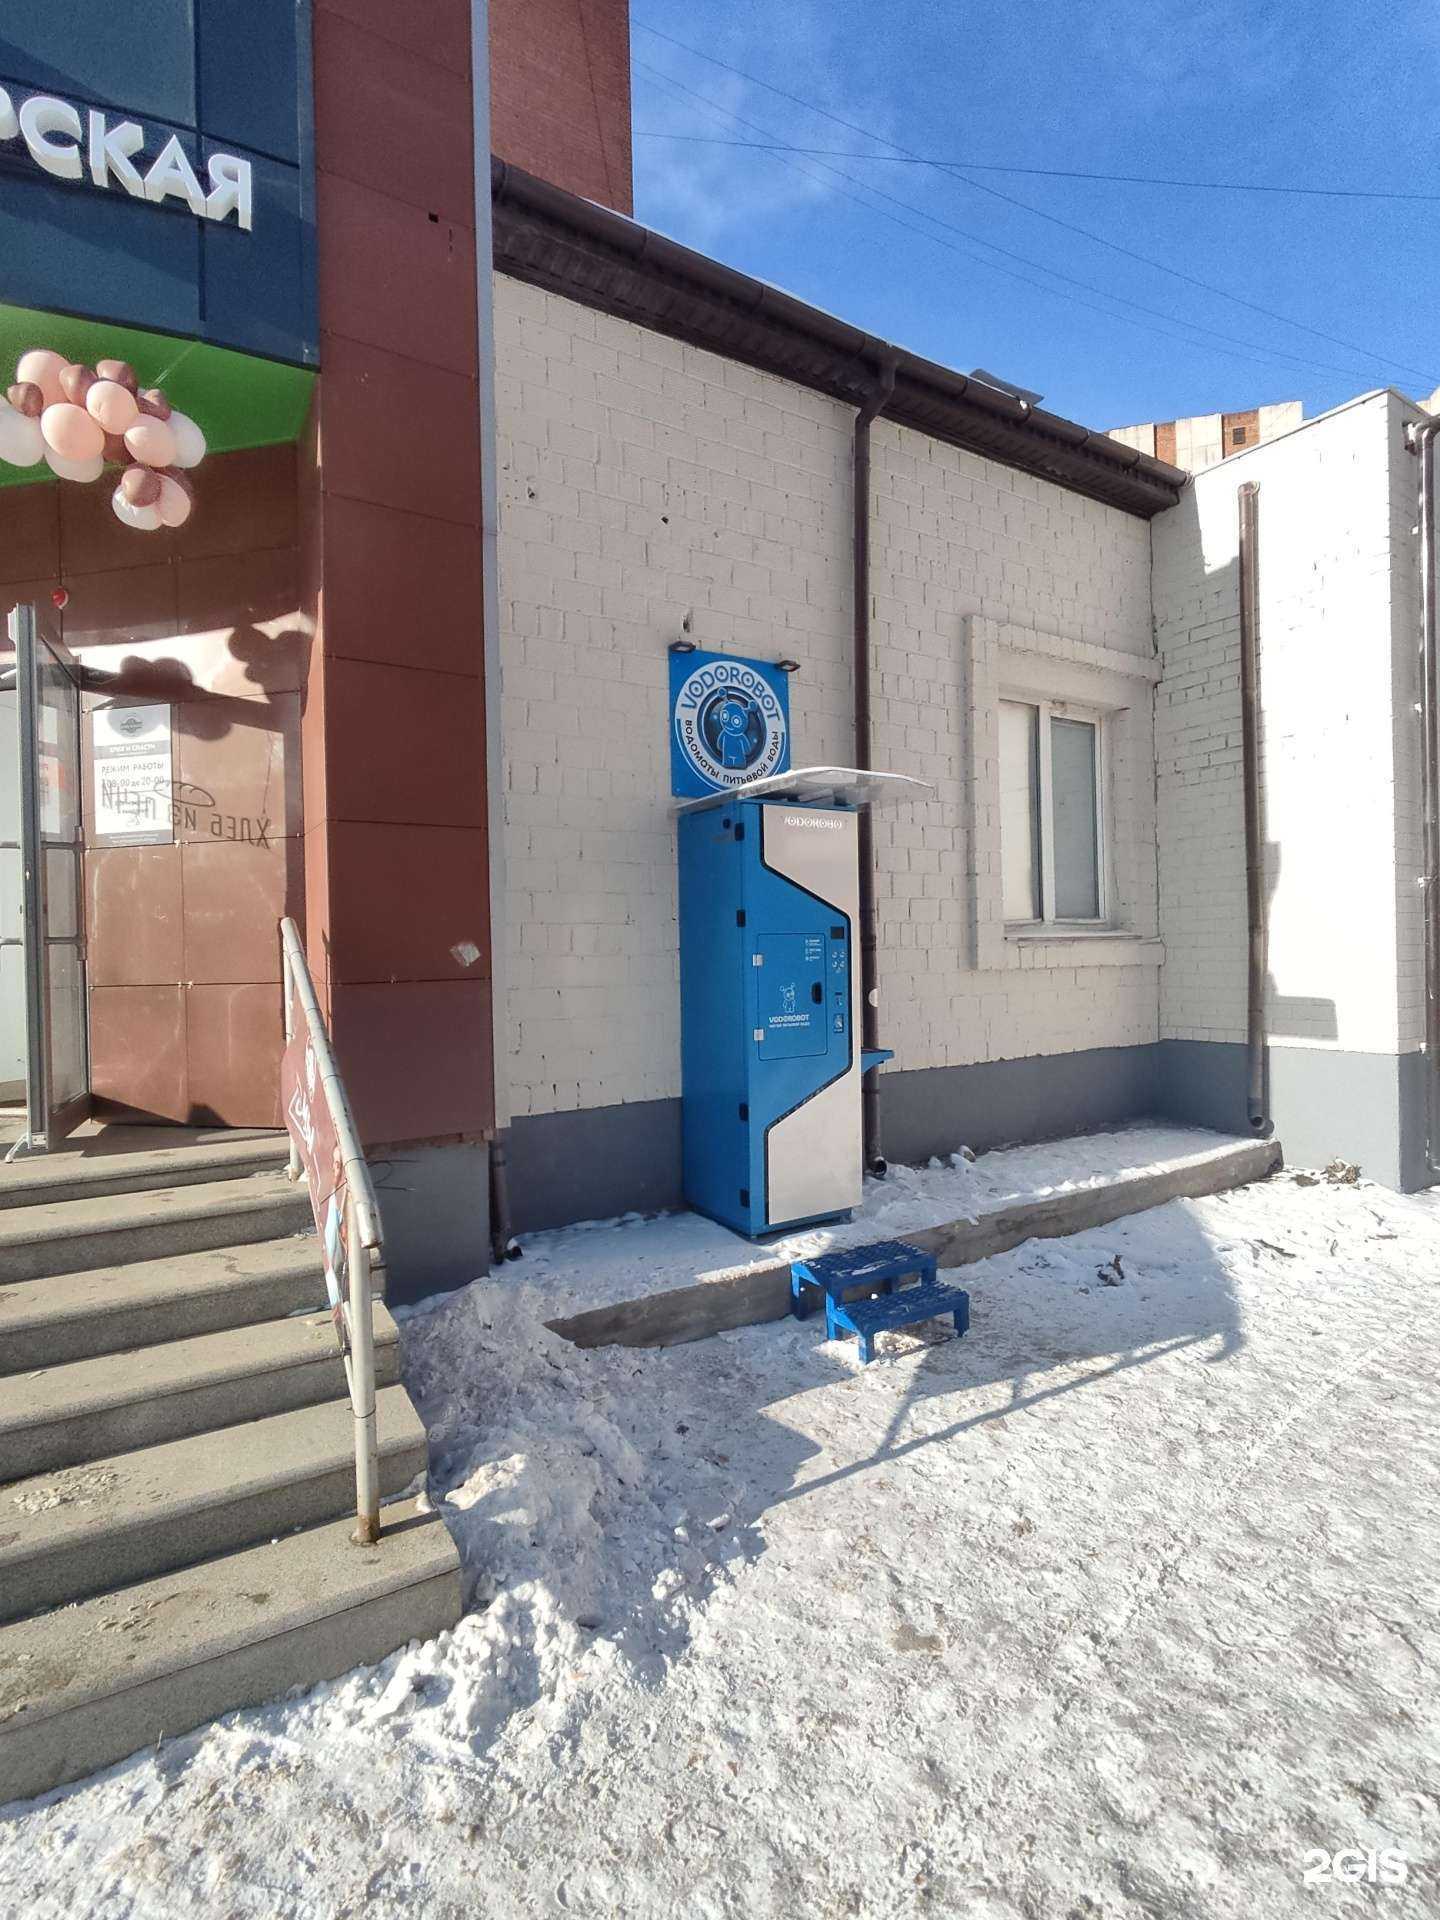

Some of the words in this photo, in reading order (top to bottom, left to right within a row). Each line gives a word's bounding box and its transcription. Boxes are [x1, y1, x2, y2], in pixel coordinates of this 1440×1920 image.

[681, 665, 780, 721] VODOROBOT
[133, 761, 164, 771] РАБОТЫ
[685, 719, 720, 780] ВОДОМОТЫ
[722, 763, 769, 786] ПИТЬЕВОЙ
[767, 731, 779, 763] ВОДЫ
